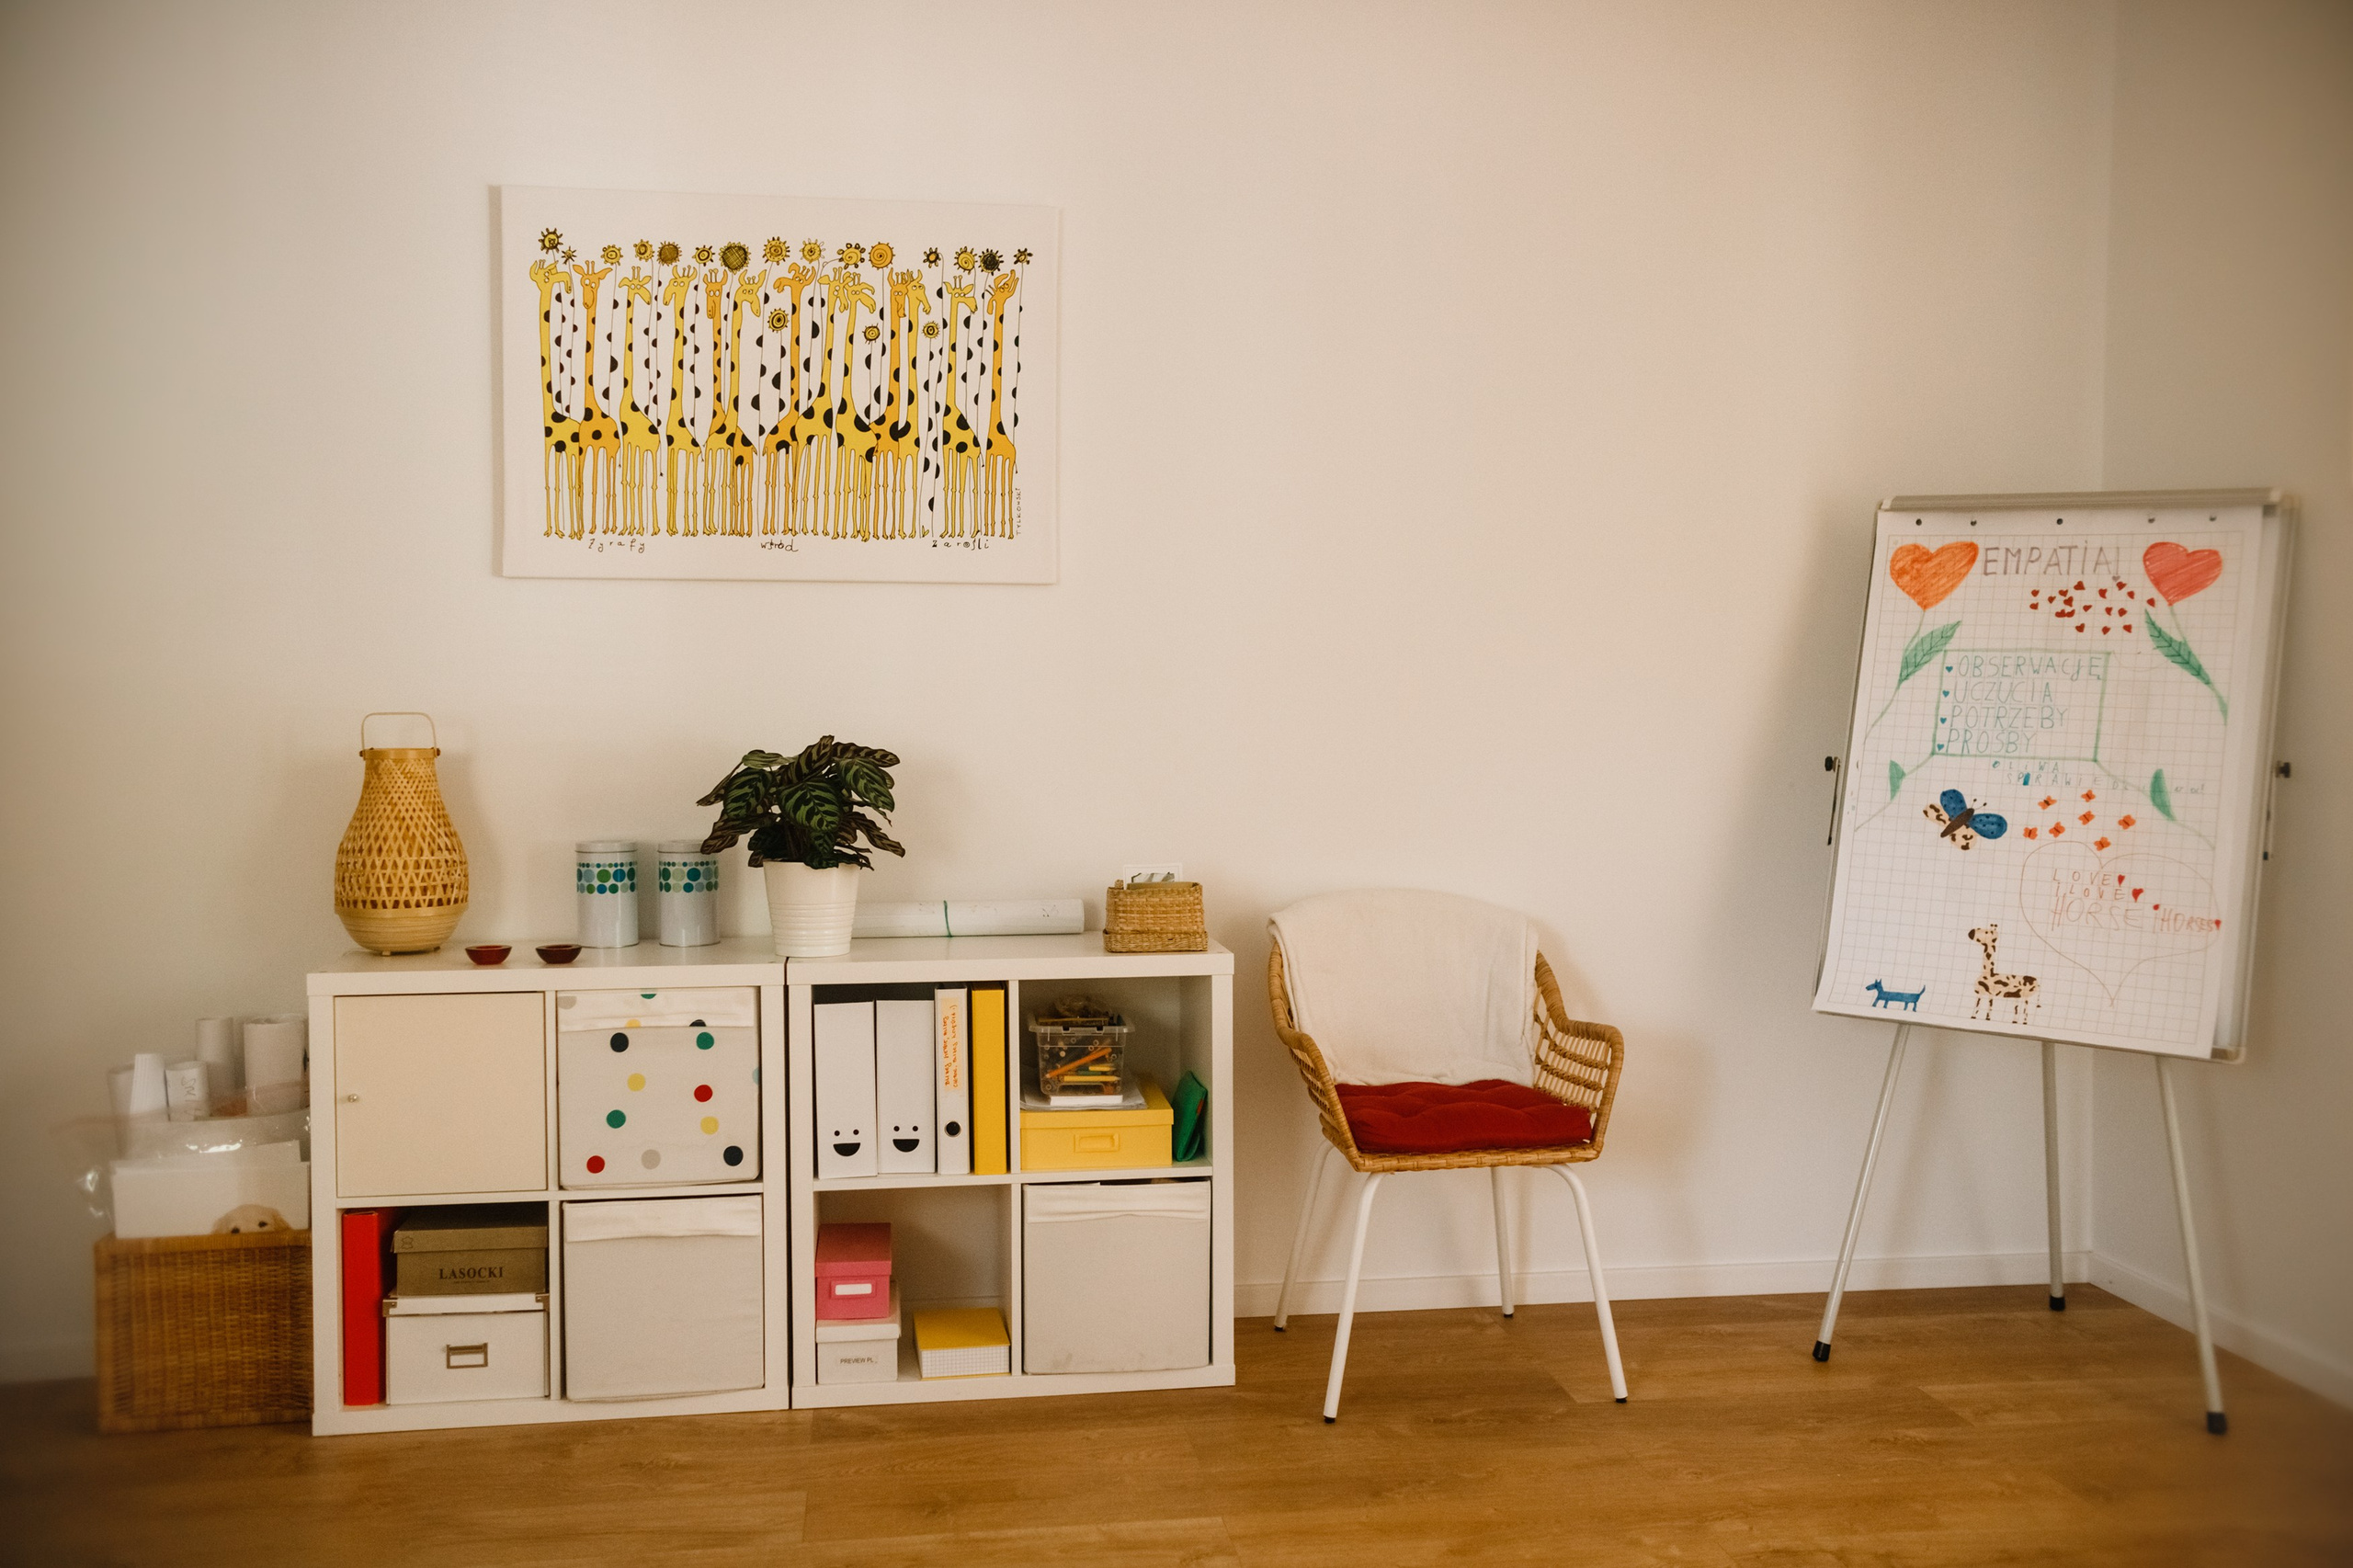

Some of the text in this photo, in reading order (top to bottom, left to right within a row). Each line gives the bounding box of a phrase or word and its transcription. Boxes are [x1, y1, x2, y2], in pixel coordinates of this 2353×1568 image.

[1953, 679, 2053, 704] UCZUCIA
[1949, 704, 2068, 729] POTRZEBY
[2051, 893, 2144, 931] HORSE
[438, 1267, 504, 1279] LASOCKI
